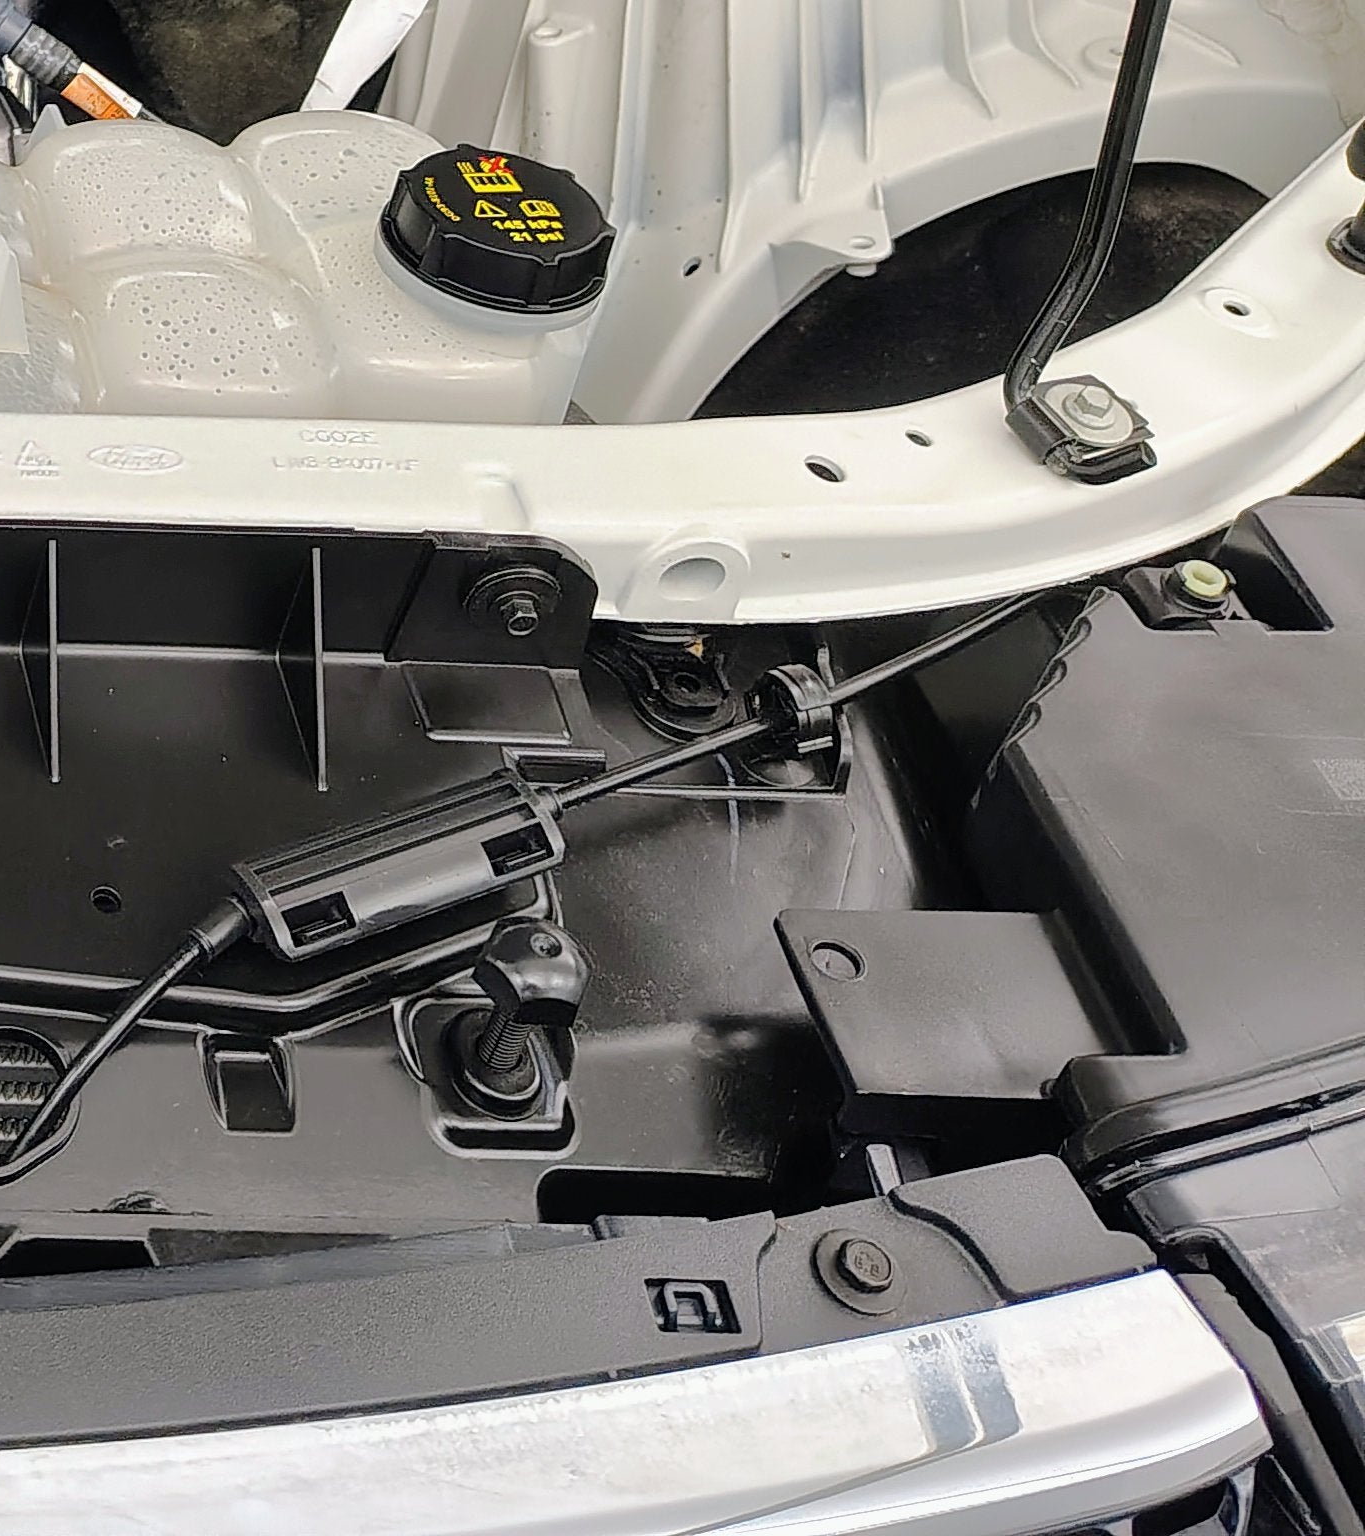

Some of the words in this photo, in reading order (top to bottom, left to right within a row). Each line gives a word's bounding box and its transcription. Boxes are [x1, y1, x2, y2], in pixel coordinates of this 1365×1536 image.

[492, 219, 526, 230] 145
[526, 219, 564, 230] kPa
[509, 231, 534, 242] 21
[535, 230, 565, 243] psi
